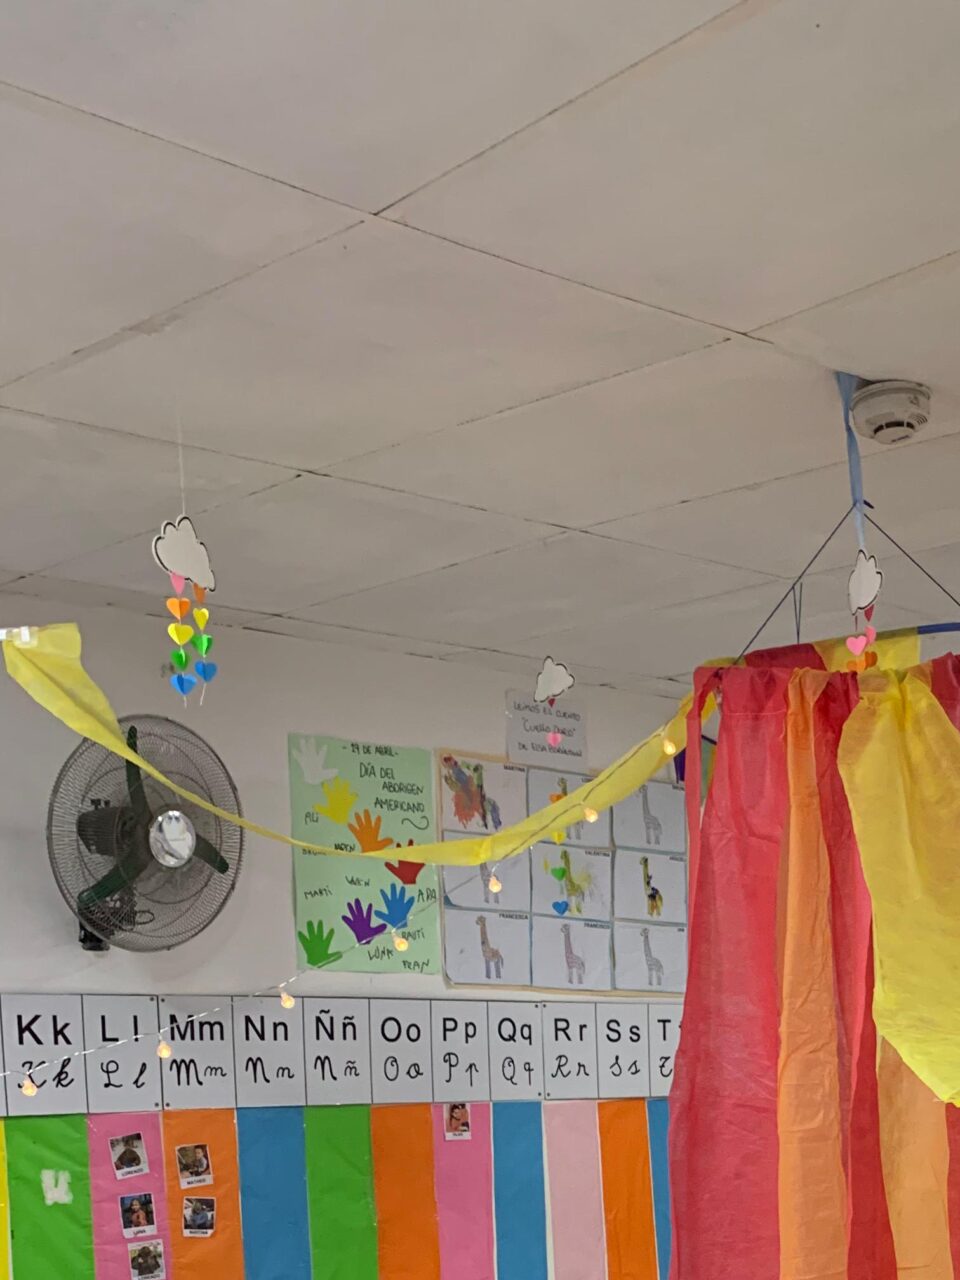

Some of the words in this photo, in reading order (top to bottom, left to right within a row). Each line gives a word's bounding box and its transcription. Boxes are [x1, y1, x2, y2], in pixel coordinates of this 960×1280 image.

[363, 745, 372, 755] DE
[380, 768, 395, 780] DEL
[382, 781, 424, 796] ABORIGEN
[374, 797, 425, 814] AMERICANO
[367, 945, 394, 961] LUNA
[402, 958, 429, 974] FRAN
[169, 1014, 225, 1041] Mm
[244, 1015, 289, 1041] Nn
[315, 1009, 357, 1042] Ññ
[381, 1017, 421, 1043] Oo
[443, 1017, 477, 1044] Pp
[498, 1017, 532, 1046] Qq
[554, 1018, 587, 1041] Rr
[606, 1019, 641, 1042] Ss
